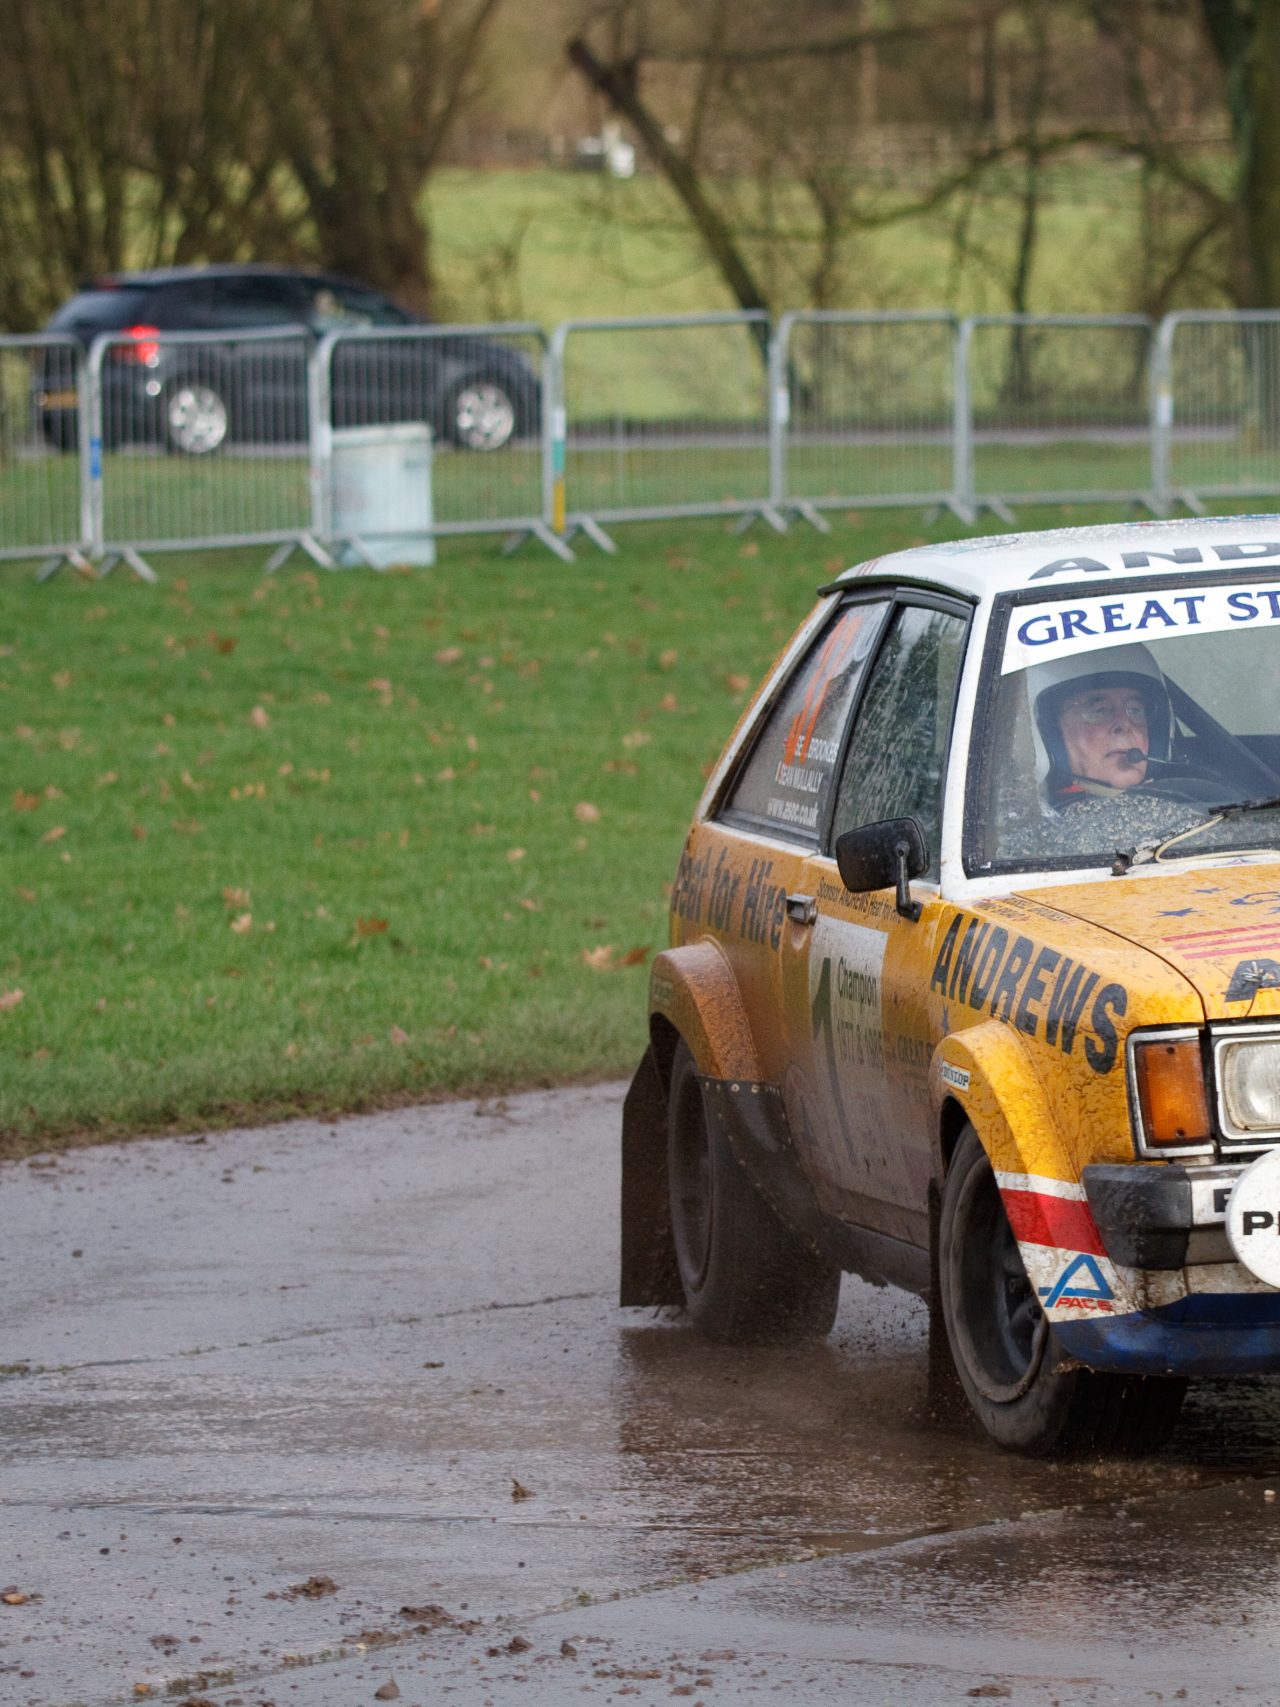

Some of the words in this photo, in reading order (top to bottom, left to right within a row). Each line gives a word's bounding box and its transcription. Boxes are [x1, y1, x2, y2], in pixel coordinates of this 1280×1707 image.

[1017, 594, 1206, 647] GREAT
[740, 858, 787, 952] Hire
[837, 956, 877, 1014] Champion
[930, 913, 1129, 1075] ANDREWS
[942, 1063, 969, 1087] DUNLOP
[1055, 1296, 1114, 1312] PACE
